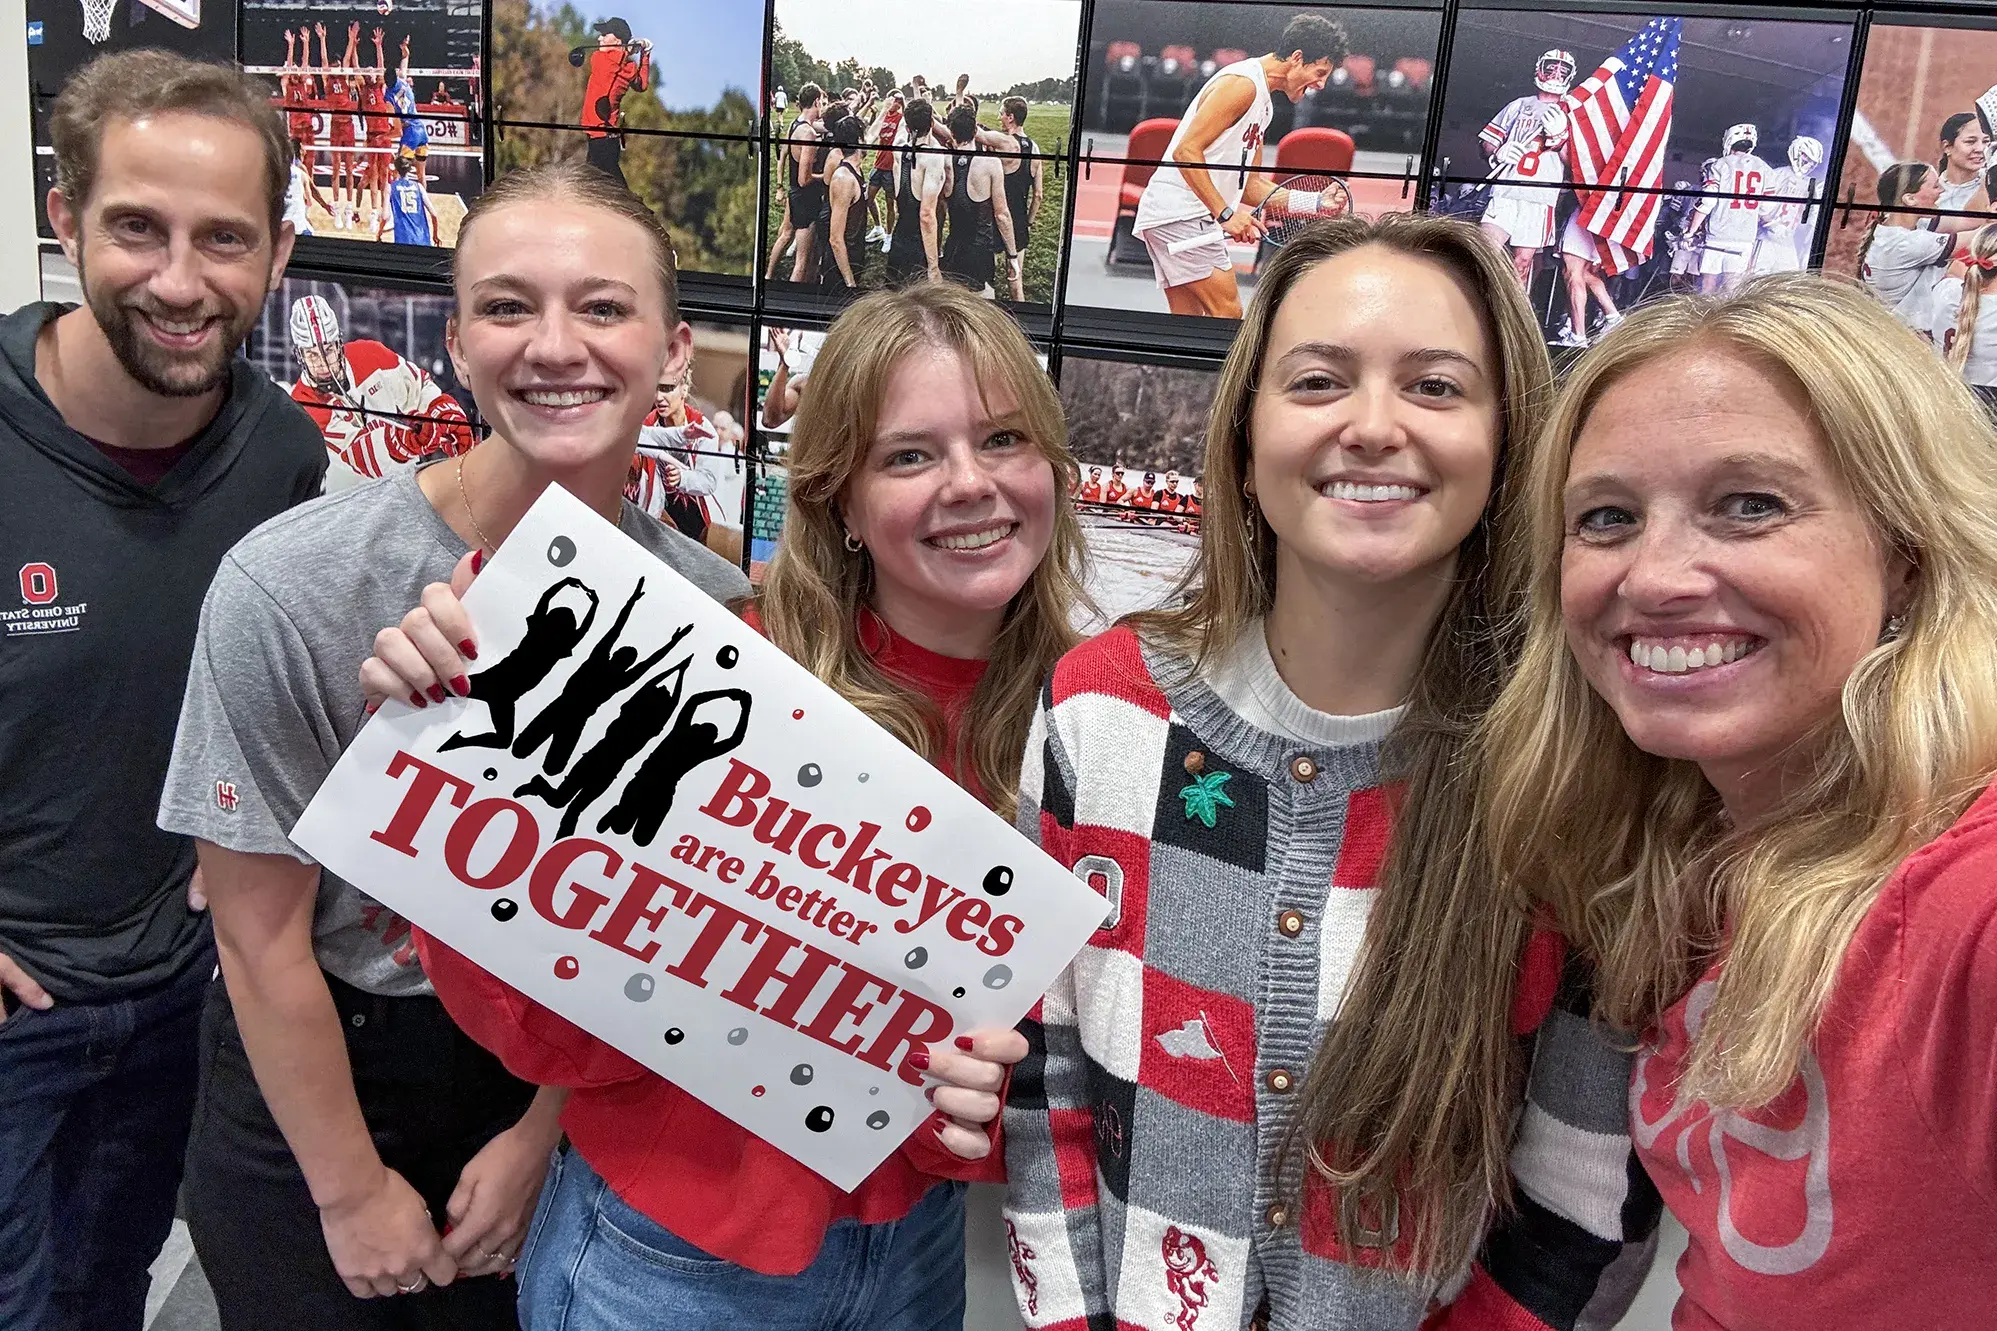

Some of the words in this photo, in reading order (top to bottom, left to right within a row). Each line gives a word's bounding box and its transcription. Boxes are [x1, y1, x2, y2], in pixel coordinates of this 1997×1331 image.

[370, 750, 955, 1087] TOGETHER
[670, 834, 745, 884] are
[744, 861, 878, 946] better
[698, 757, 1025, 957] Buckeyes
